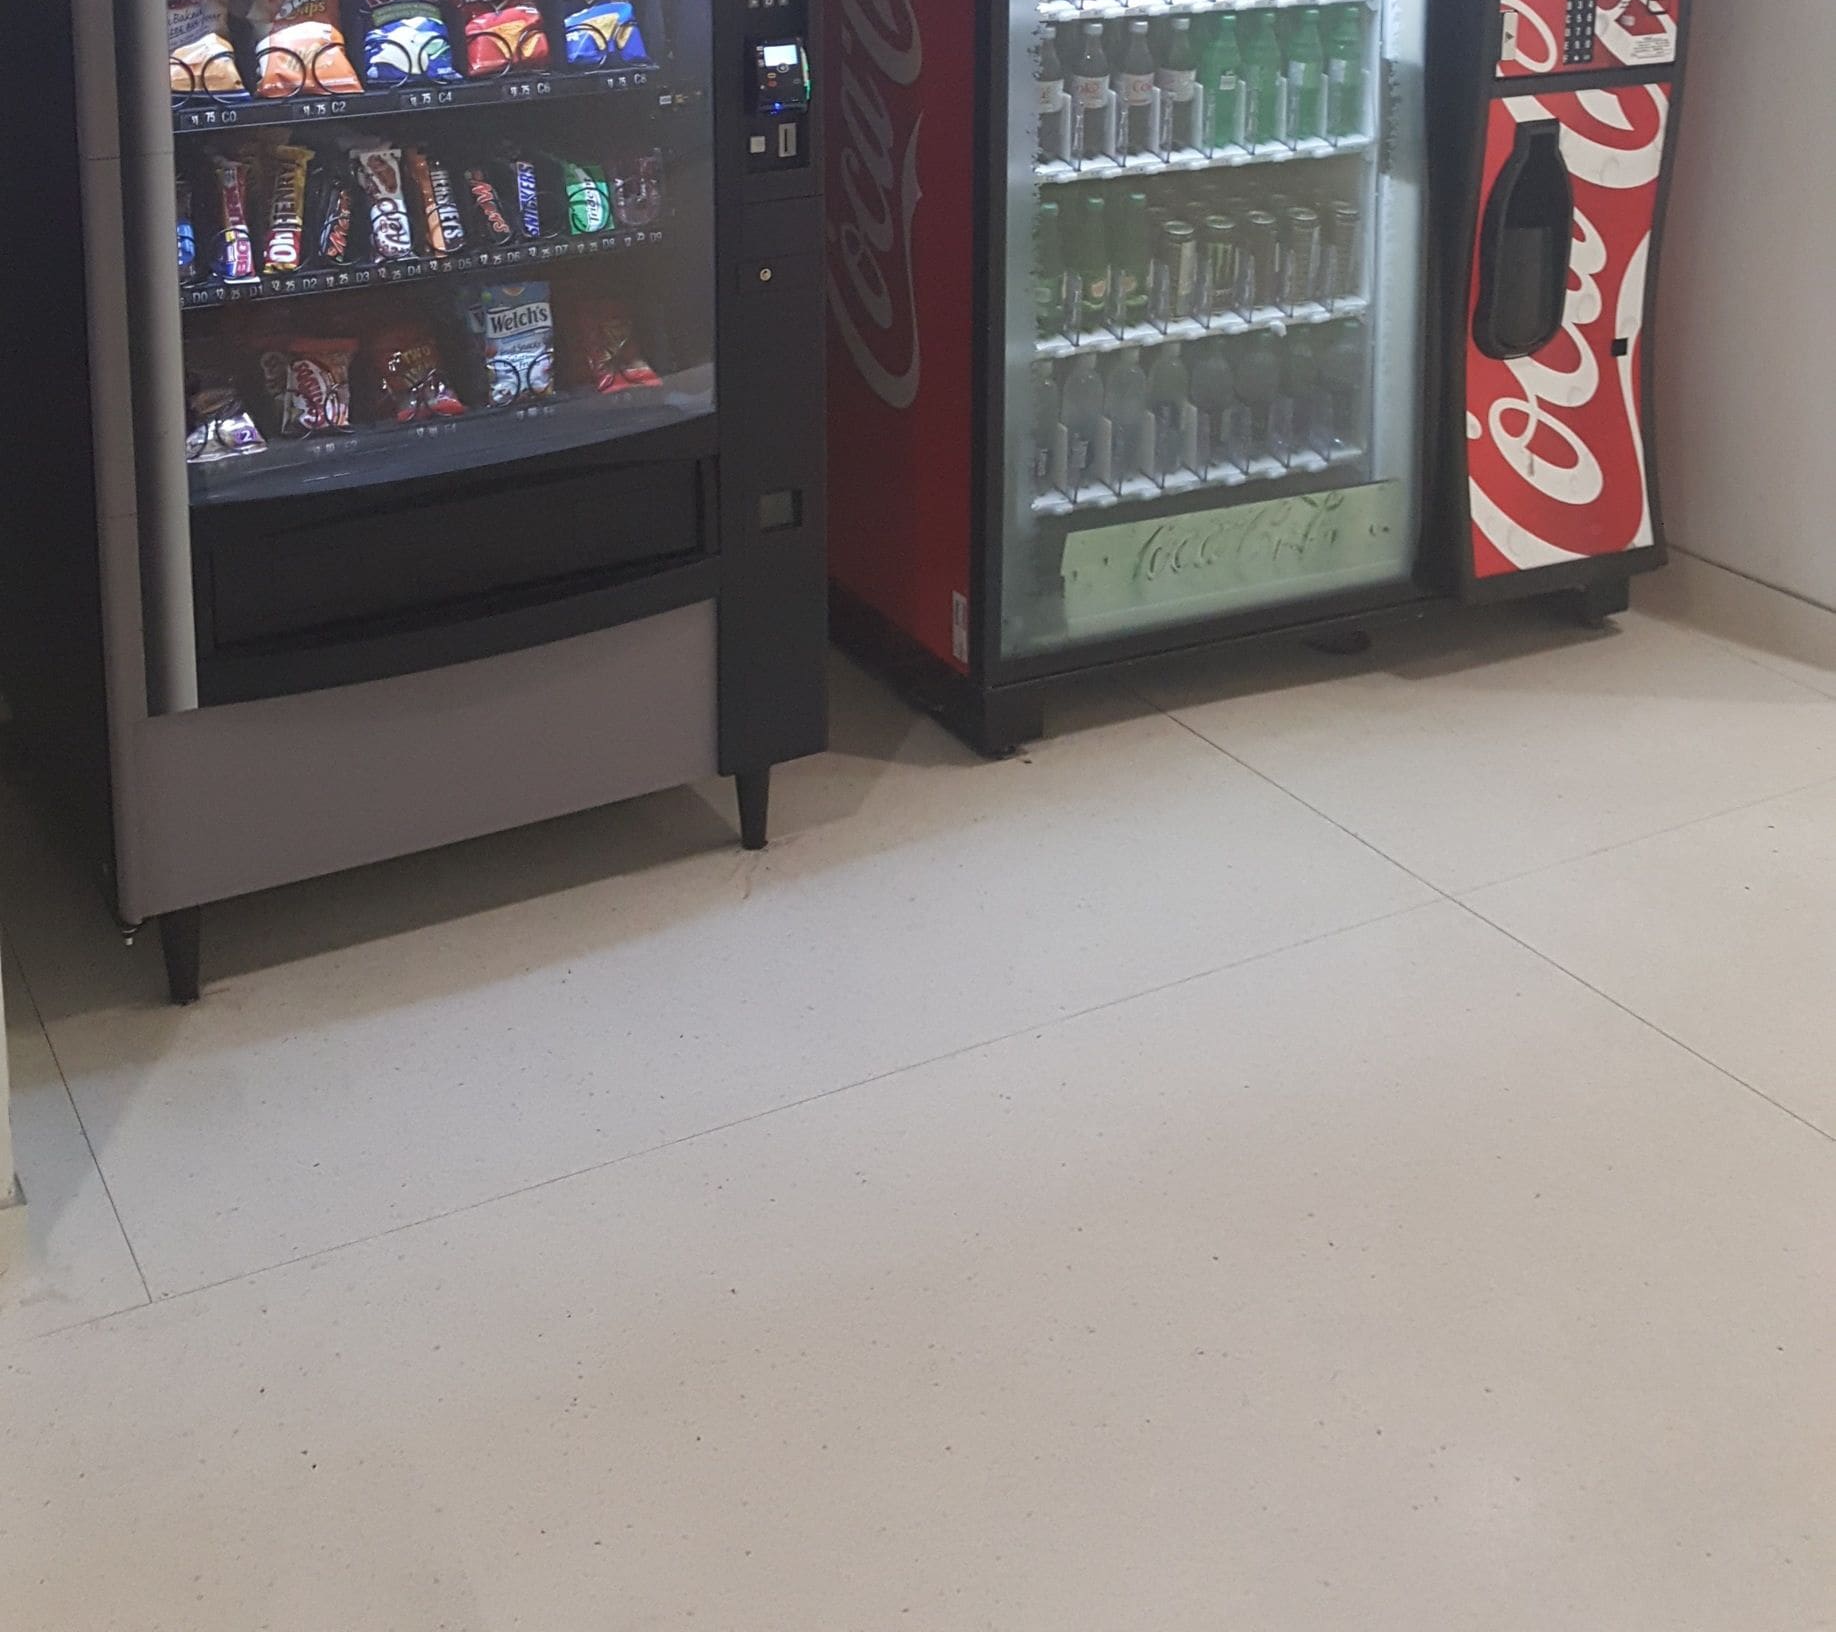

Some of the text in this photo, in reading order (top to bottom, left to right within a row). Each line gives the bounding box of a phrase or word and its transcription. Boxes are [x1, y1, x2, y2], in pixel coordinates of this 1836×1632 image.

[332, 101, 346, 113] C2
[438, 91, 452, 104] C4
[221, 111, 237, 124] C0
[471, 182, 510, 234] Mars
[515, 161, 541, 238] SNICKERS
[267, 229, 298, 263] Oh
[490, 306, 549, 334] Welch's
[242, 430, 253, 442] 2
